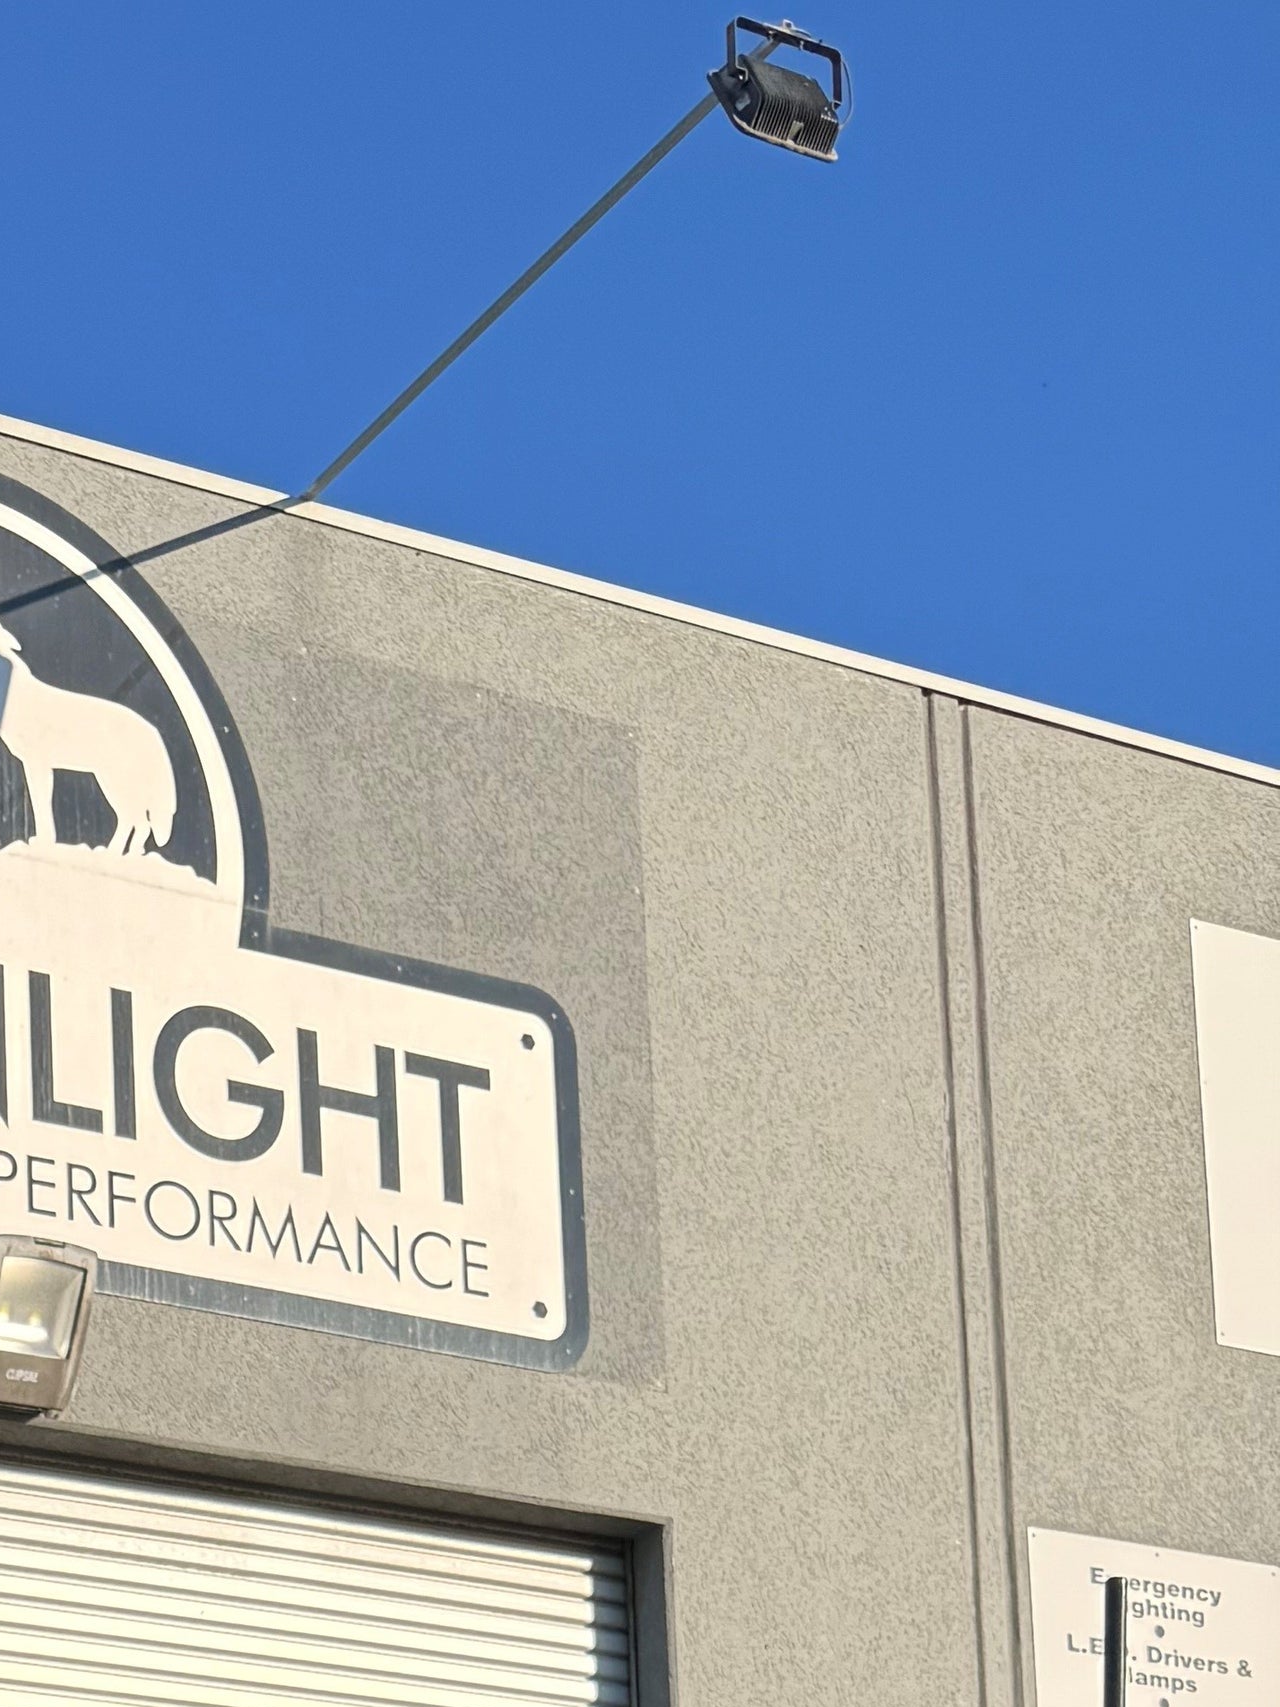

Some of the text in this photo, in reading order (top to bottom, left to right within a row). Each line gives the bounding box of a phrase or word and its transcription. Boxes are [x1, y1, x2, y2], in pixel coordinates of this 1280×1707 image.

[1089, 1566, 1222, 1607] Eergency
[1128, 1599, 1205, 1628] ghting
[1146, 1645, 1229, 1675] Drivers
[1236, 1659, 1253, 1678] &
[1128, 1666, 1198, 1694] lamps
